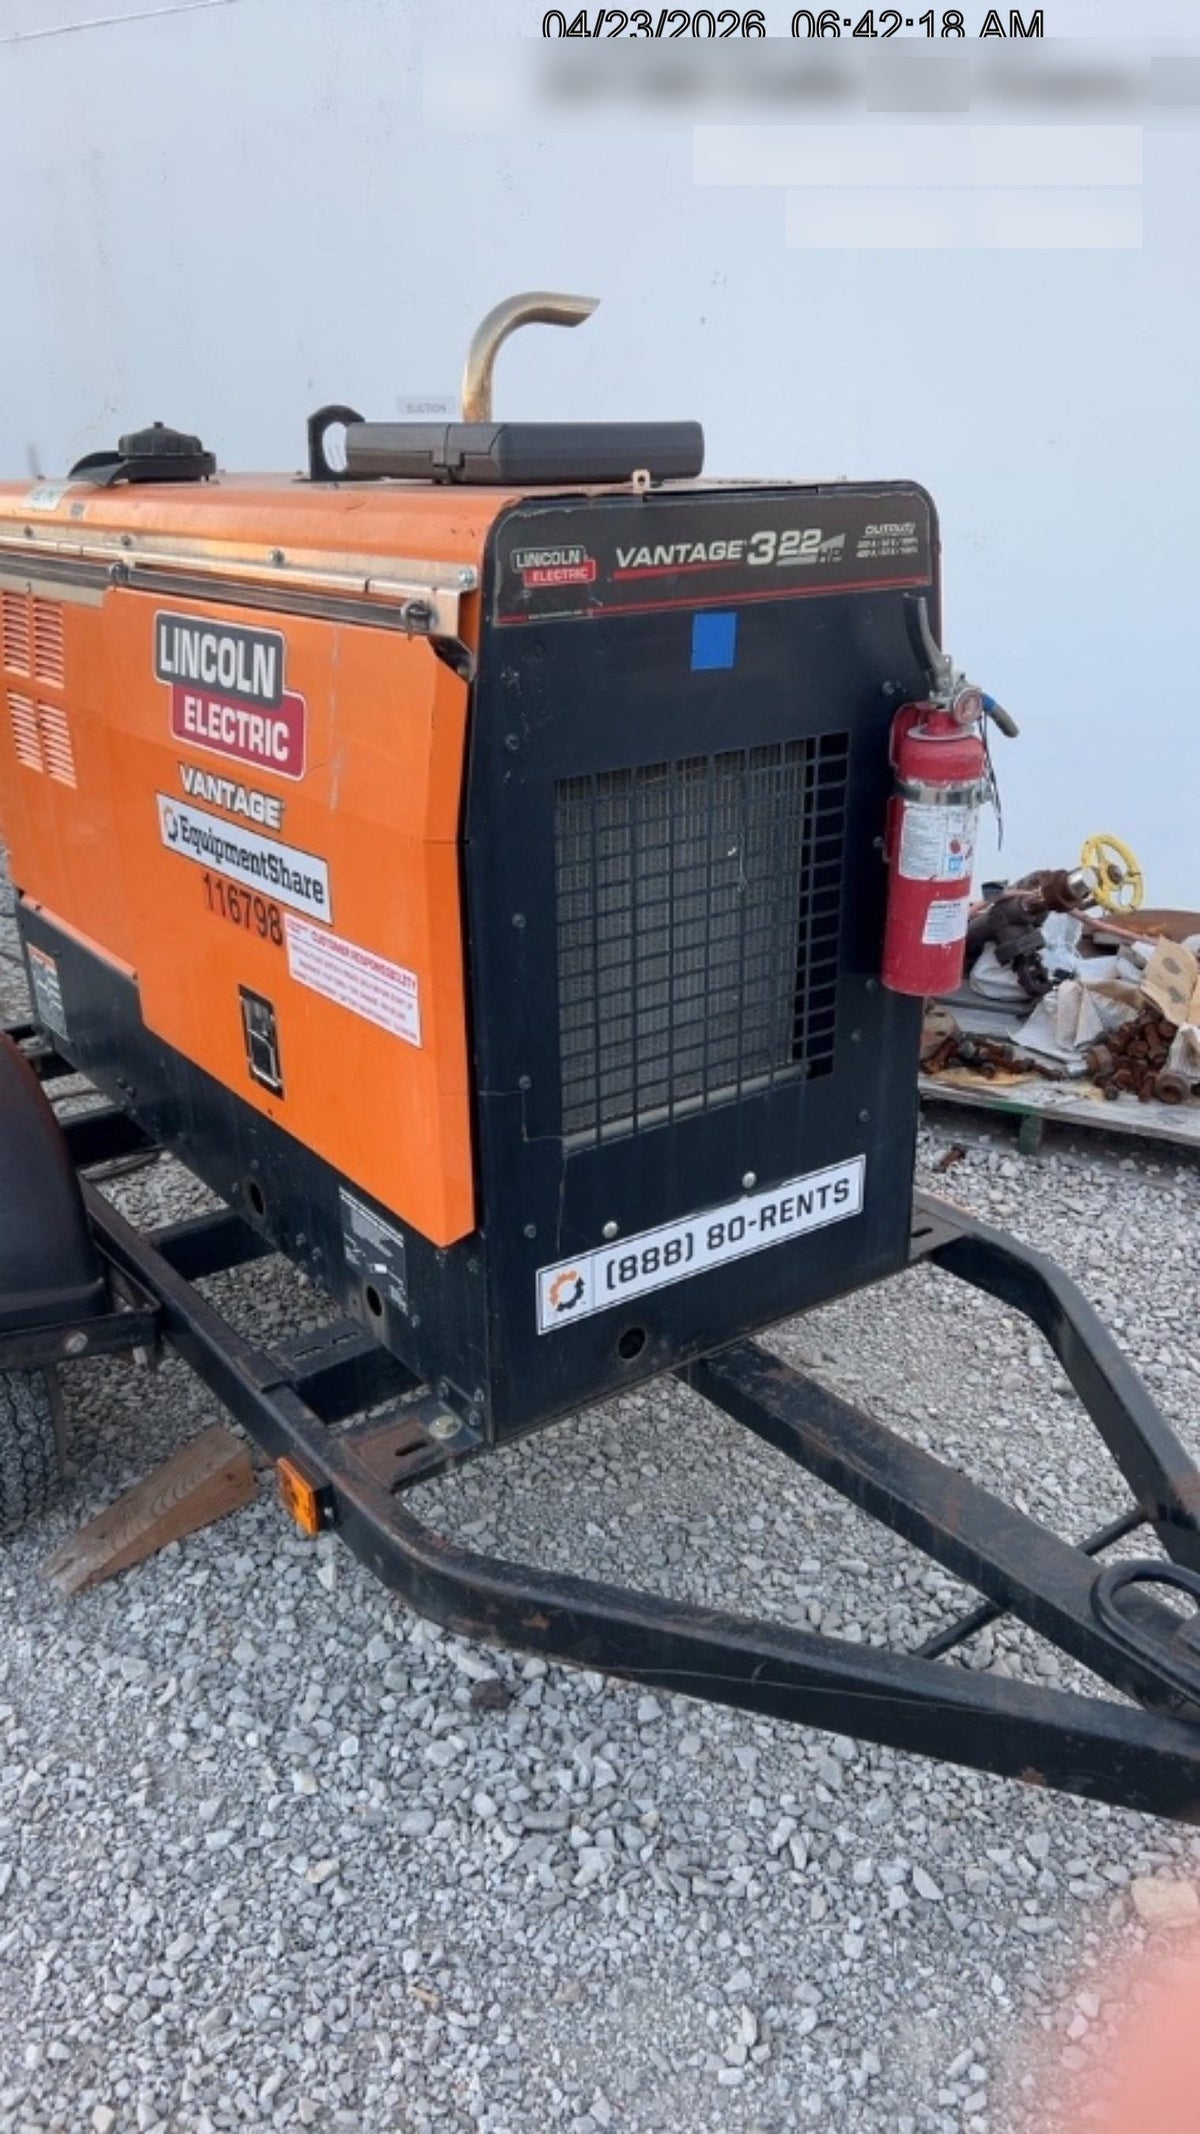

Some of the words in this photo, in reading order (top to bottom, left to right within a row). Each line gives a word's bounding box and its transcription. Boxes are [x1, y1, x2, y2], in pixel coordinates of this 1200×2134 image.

[516, 549, 581, 568] LINCOLN
[532, 567, 589, 583] ELECTRIC
[615, 540, 745, 568] VANTAGE
[747, 528, 822, 566] 322
[159, 624, 276, 699] LINCOLN
[183, 698, 290, 761] ELECTRIC
[178, 762, 283, 829] VANTAGE
[179, 813, 325, 905] EquipmentShare
[202, 872, 284, 947] 116798
[605, 1233, 694, 1290] (888)
[706, 1177, 850, 1251] 80-RENTS
